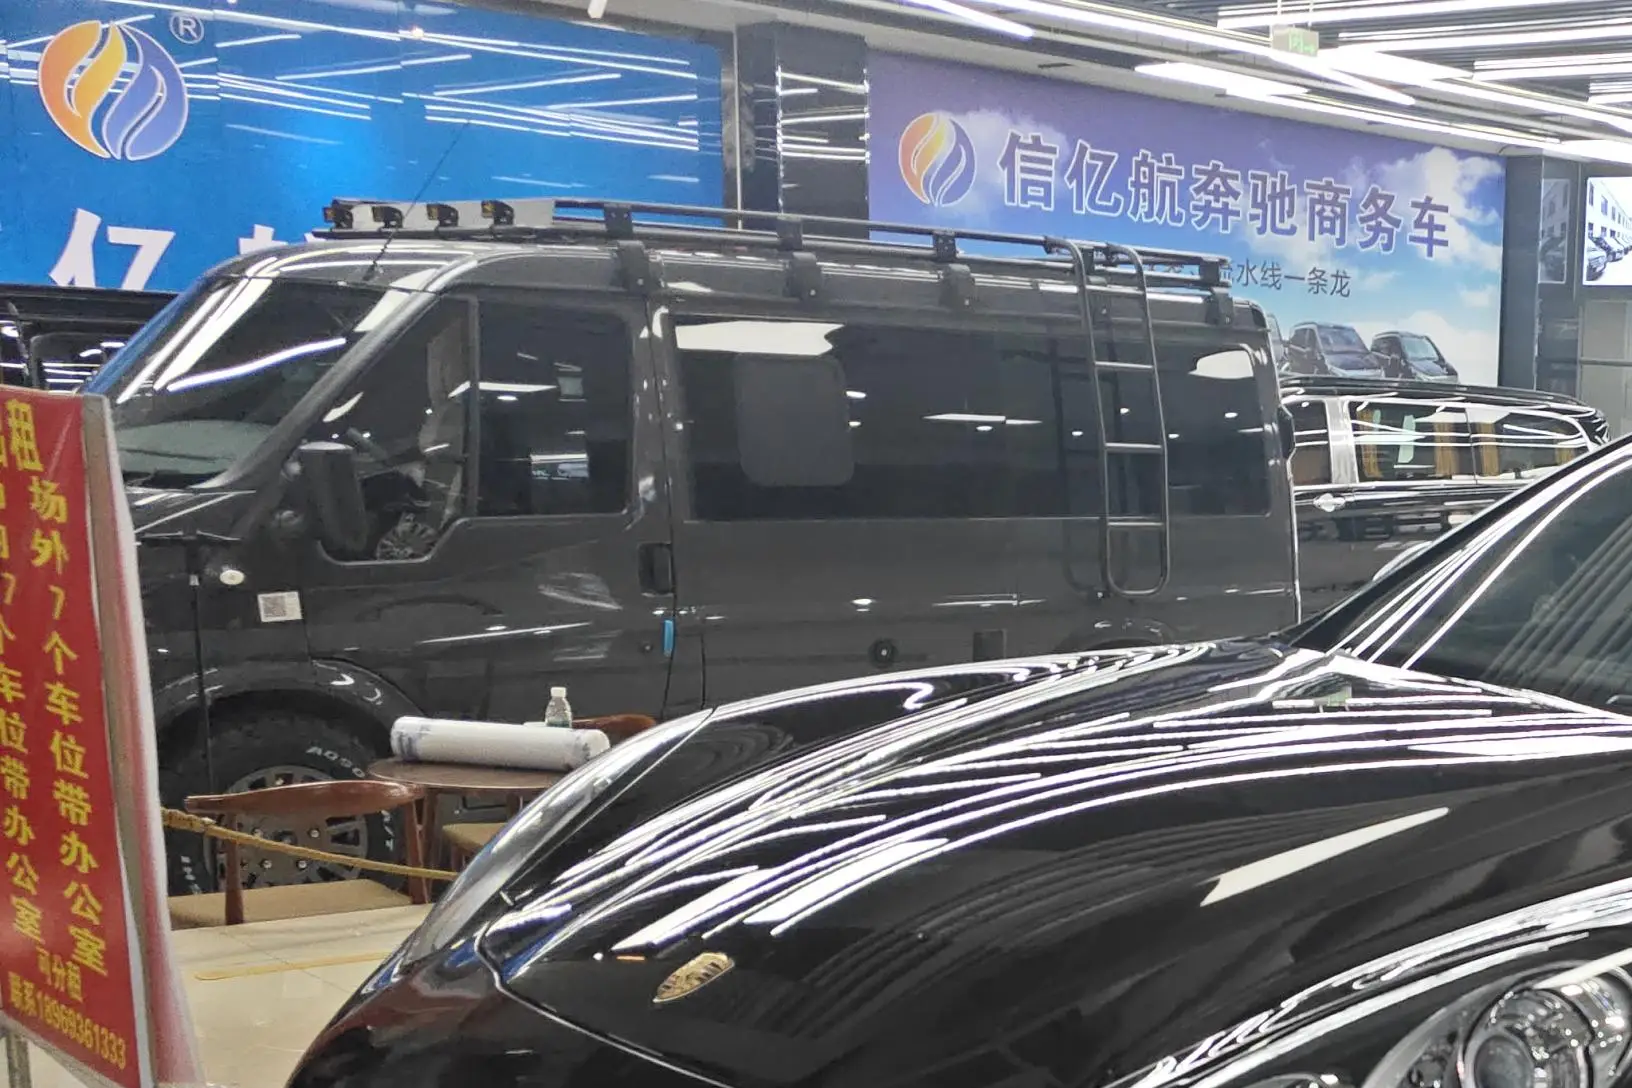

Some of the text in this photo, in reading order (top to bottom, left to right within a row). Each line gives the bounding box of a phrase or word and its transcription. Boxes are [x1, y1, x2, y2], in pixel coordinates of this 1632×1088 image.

[997, 129, 1451, 259] 信亿航奔驰商务车
[0, 398, 44, 472] 租
